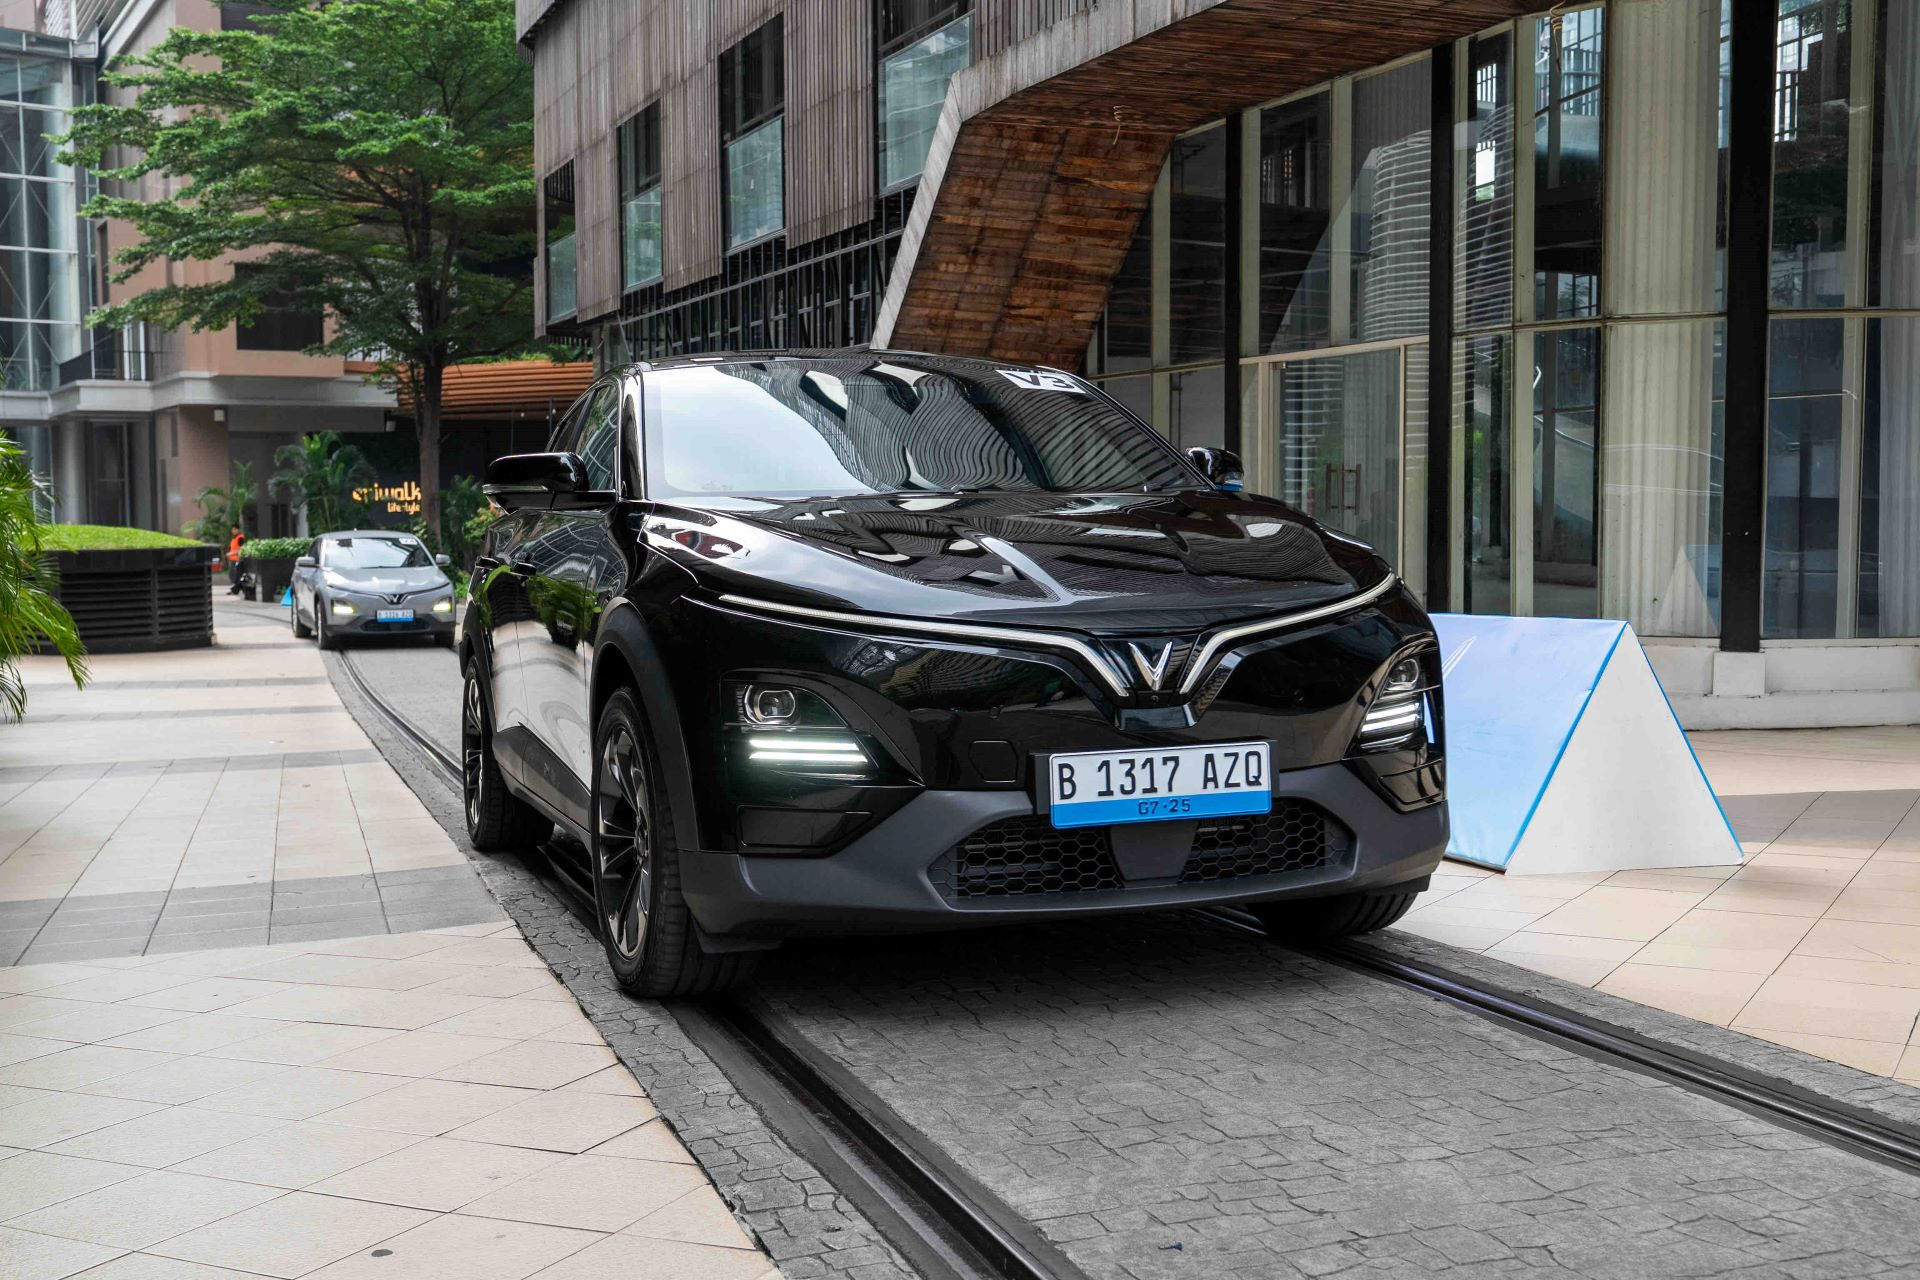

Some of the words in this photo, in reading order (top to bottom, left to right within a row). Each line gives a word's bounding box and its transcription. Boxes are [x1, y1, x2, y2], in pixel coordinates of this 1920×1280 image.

[1006, 372, 1075, 389] V3
[1058, 763, 1077, 801] B
[1097, 756, 1180, 797] 1317
[1202, 750, 1263, 790] AZQ
